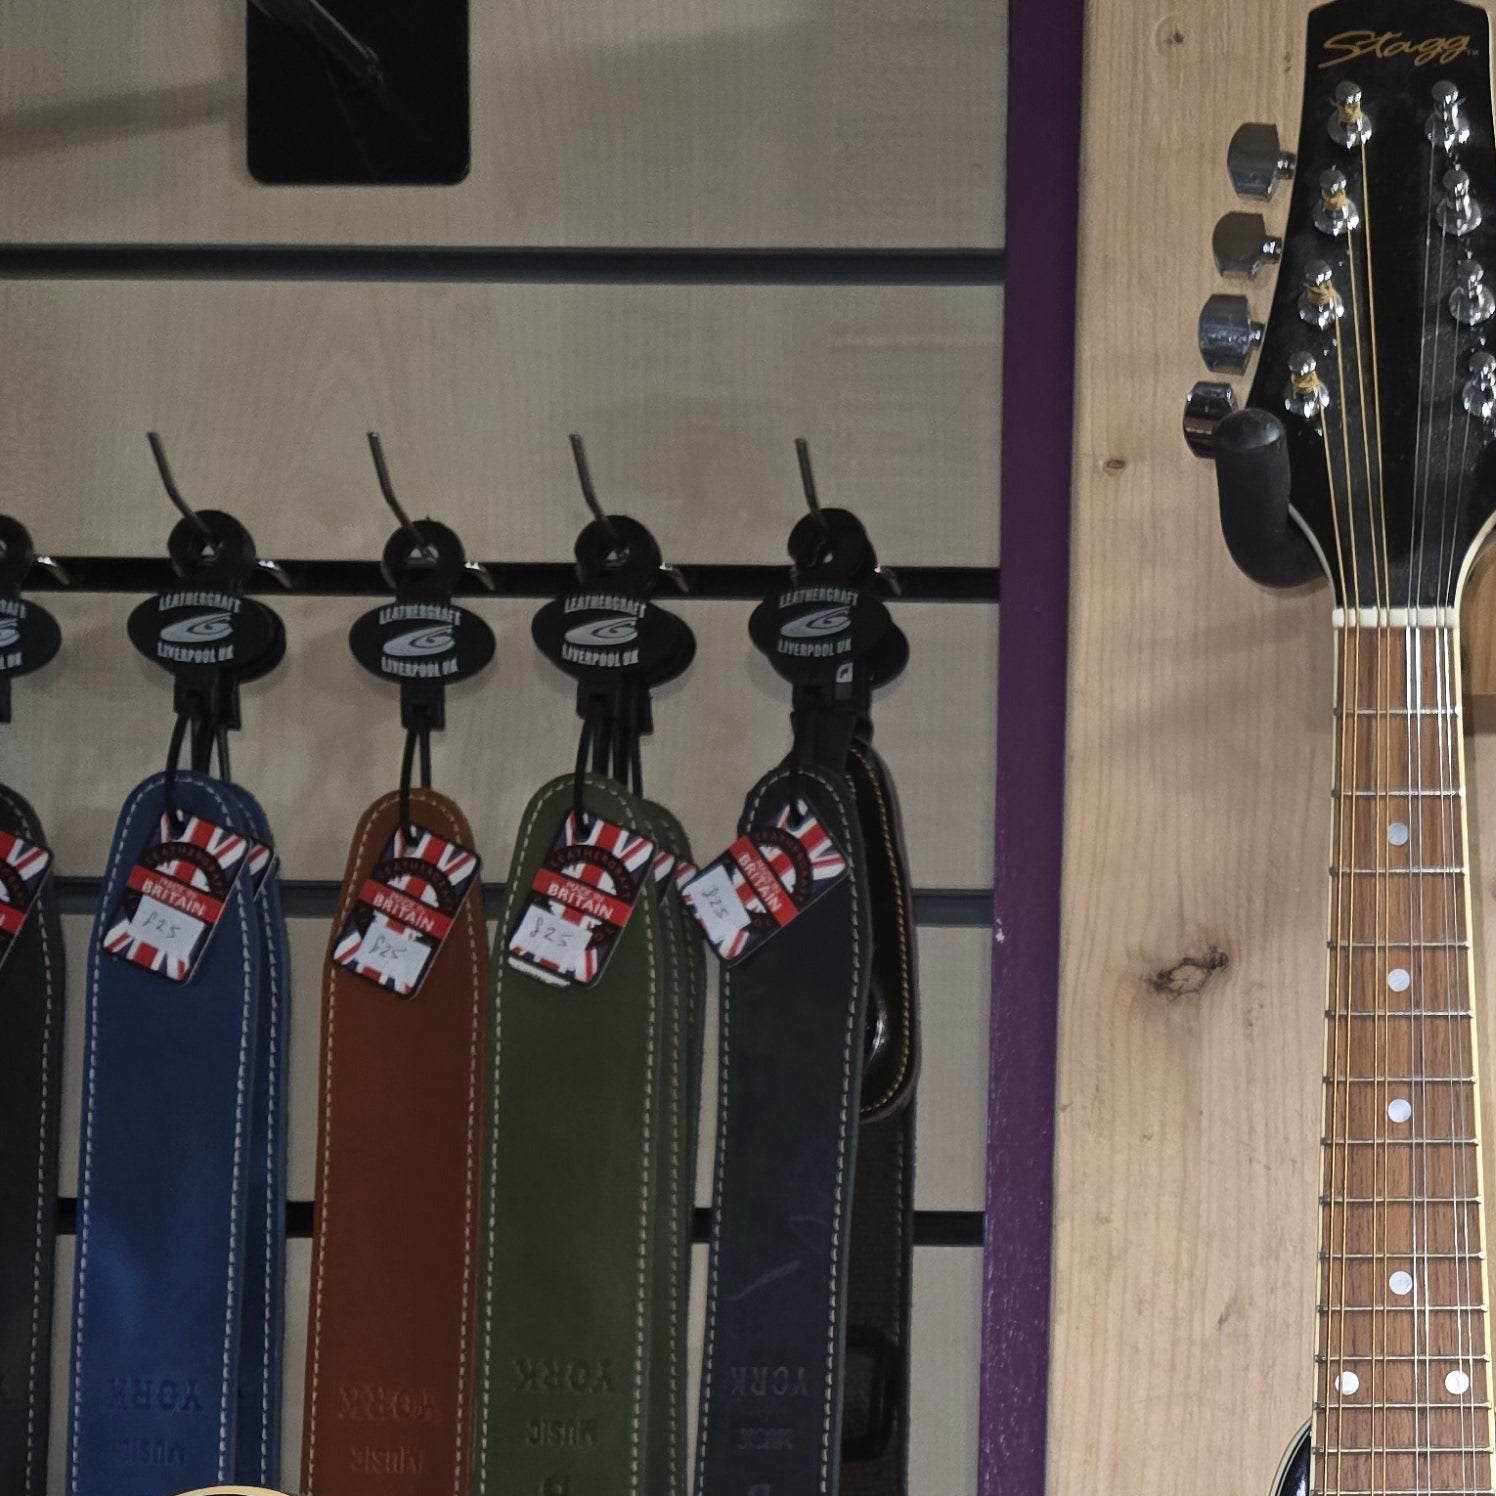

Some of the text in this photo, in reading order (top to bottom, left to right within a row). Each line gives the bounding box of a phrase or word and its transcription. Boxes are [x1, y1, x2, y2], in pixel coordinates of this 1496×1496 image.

[1318, 30, 1470, 69] Stagg
[157, 641, 234, 663] LIVERPOOL UK
[562, 643, 638, 667] LIVERPOOL UK
[777, 638, 852, 658] LIVERPOOL UK
[381, 655, 459, 678] LIVERPOOL UK
[738, 852, 782, 912] BRITAIN
[141, 879, 206, 916] BRITAIN
[372, 893, 435, 932] BRITAIN
[547, 881, 614, 920] BRITAIN
[701, 887, 729, 919] £25
[142, 914, 181, 939] £25
[529, 917, 575, 947] £25
[368, 934, 408, 960] £25
[512, 1358, 617, 1394] YORK
[728, 1366, 810, 1397] YORK
[525, 1417, 598, 1447] MUSIC
